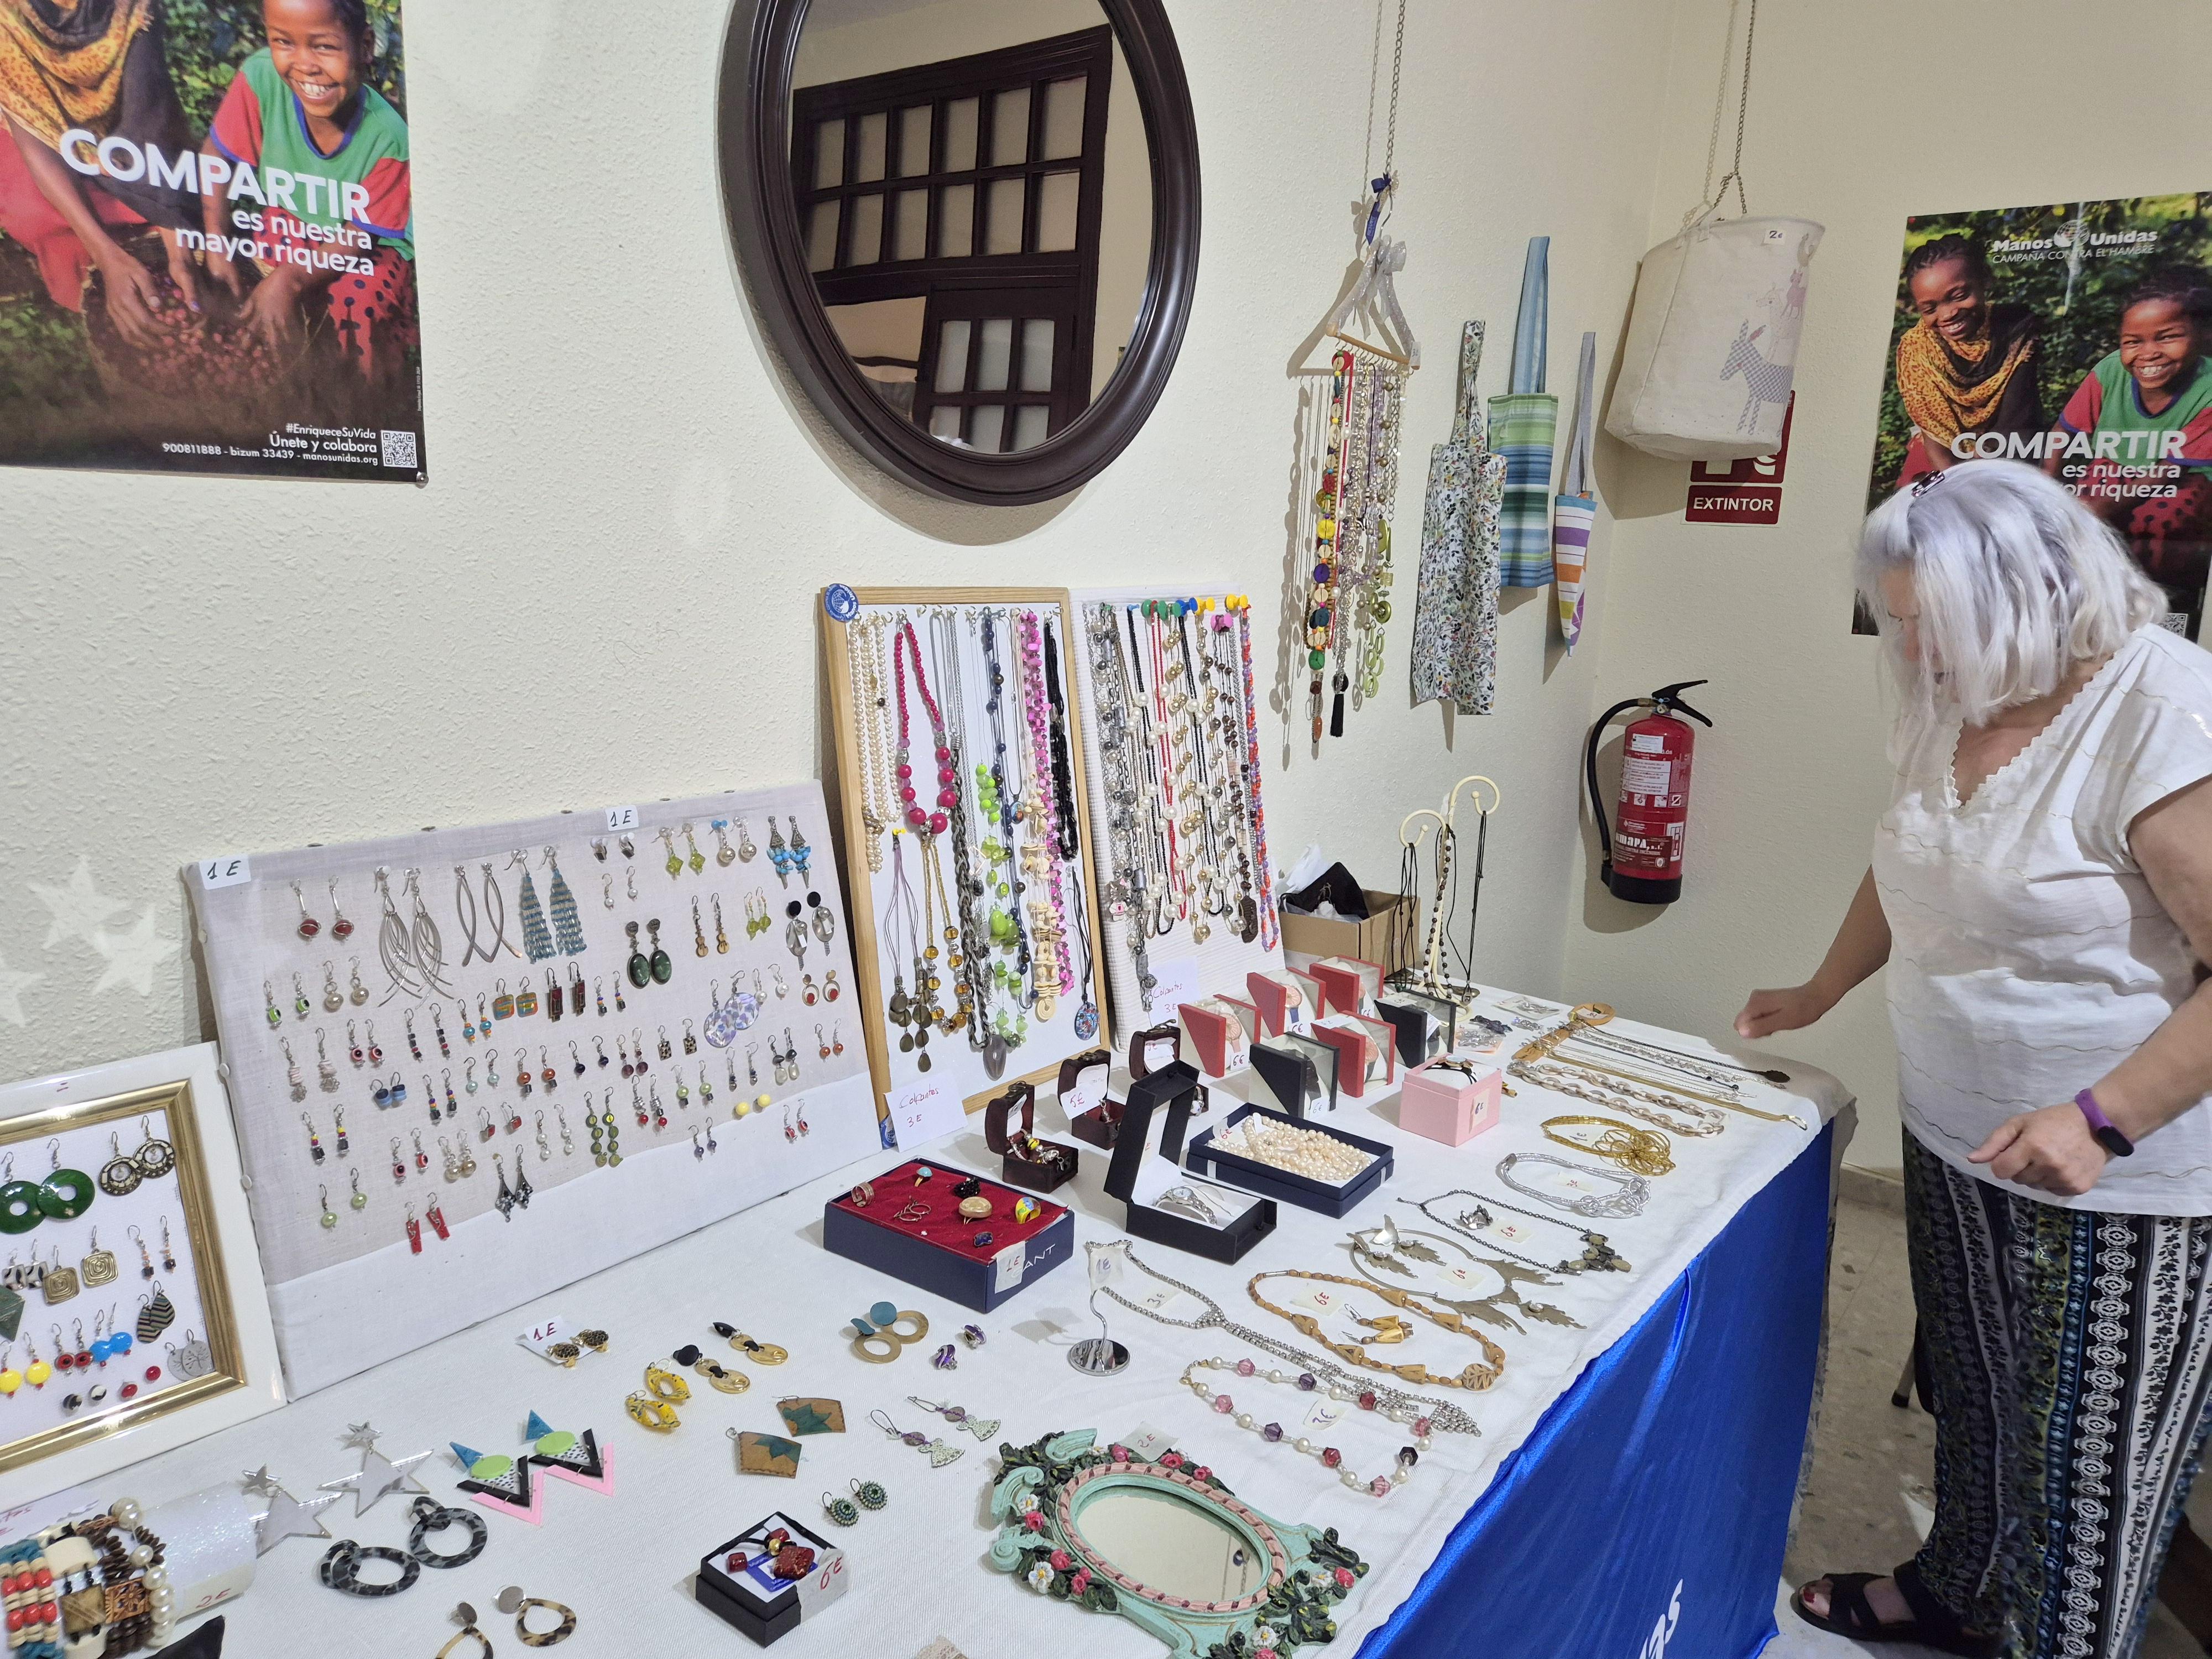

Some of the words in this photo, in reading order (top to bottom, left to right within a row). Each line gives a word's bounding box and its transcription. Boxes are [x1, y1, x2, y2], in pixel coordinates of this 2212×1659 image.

[59, 129, 372, 225] COMPARTIR
[232, 208, 263, 229] es
[270, 215, 372, 250] nuestra
[176, 227, 270, 262] mayor
[274, 239, 374, 276] riqueza
[1992, 238, 2053, 252] Manos
[2090, 230, 2158, 246] Unidas
[1992, 251, 2044, 264] CAMPAÑA
[2107, 244, 2155, 257] HAMBRE
[269, 430, 308, 450] Únete
[311, 440, 319, 452] y
[323, 439, 377, 453] colabora
[286, 424, 376, 440] #EnriqueceSuVida
[162, 443, 222, 456] 900811888
[230, 446, 260, 458] bizum
[262, 448, 294, 460] 33439
[302, 452, 378, 466] manosunidas.org
[1951, 430, 2188, 460] COMPARTIR
[2062, 465, 2087, 478] es
[2093, 461, 2181, 478] nuestra
[2090, 479, 2178, 502] riqueza
[1693, 497, 1774, 512] EXTINTOR
[1018, 1243, 1056, 1274] ANT
